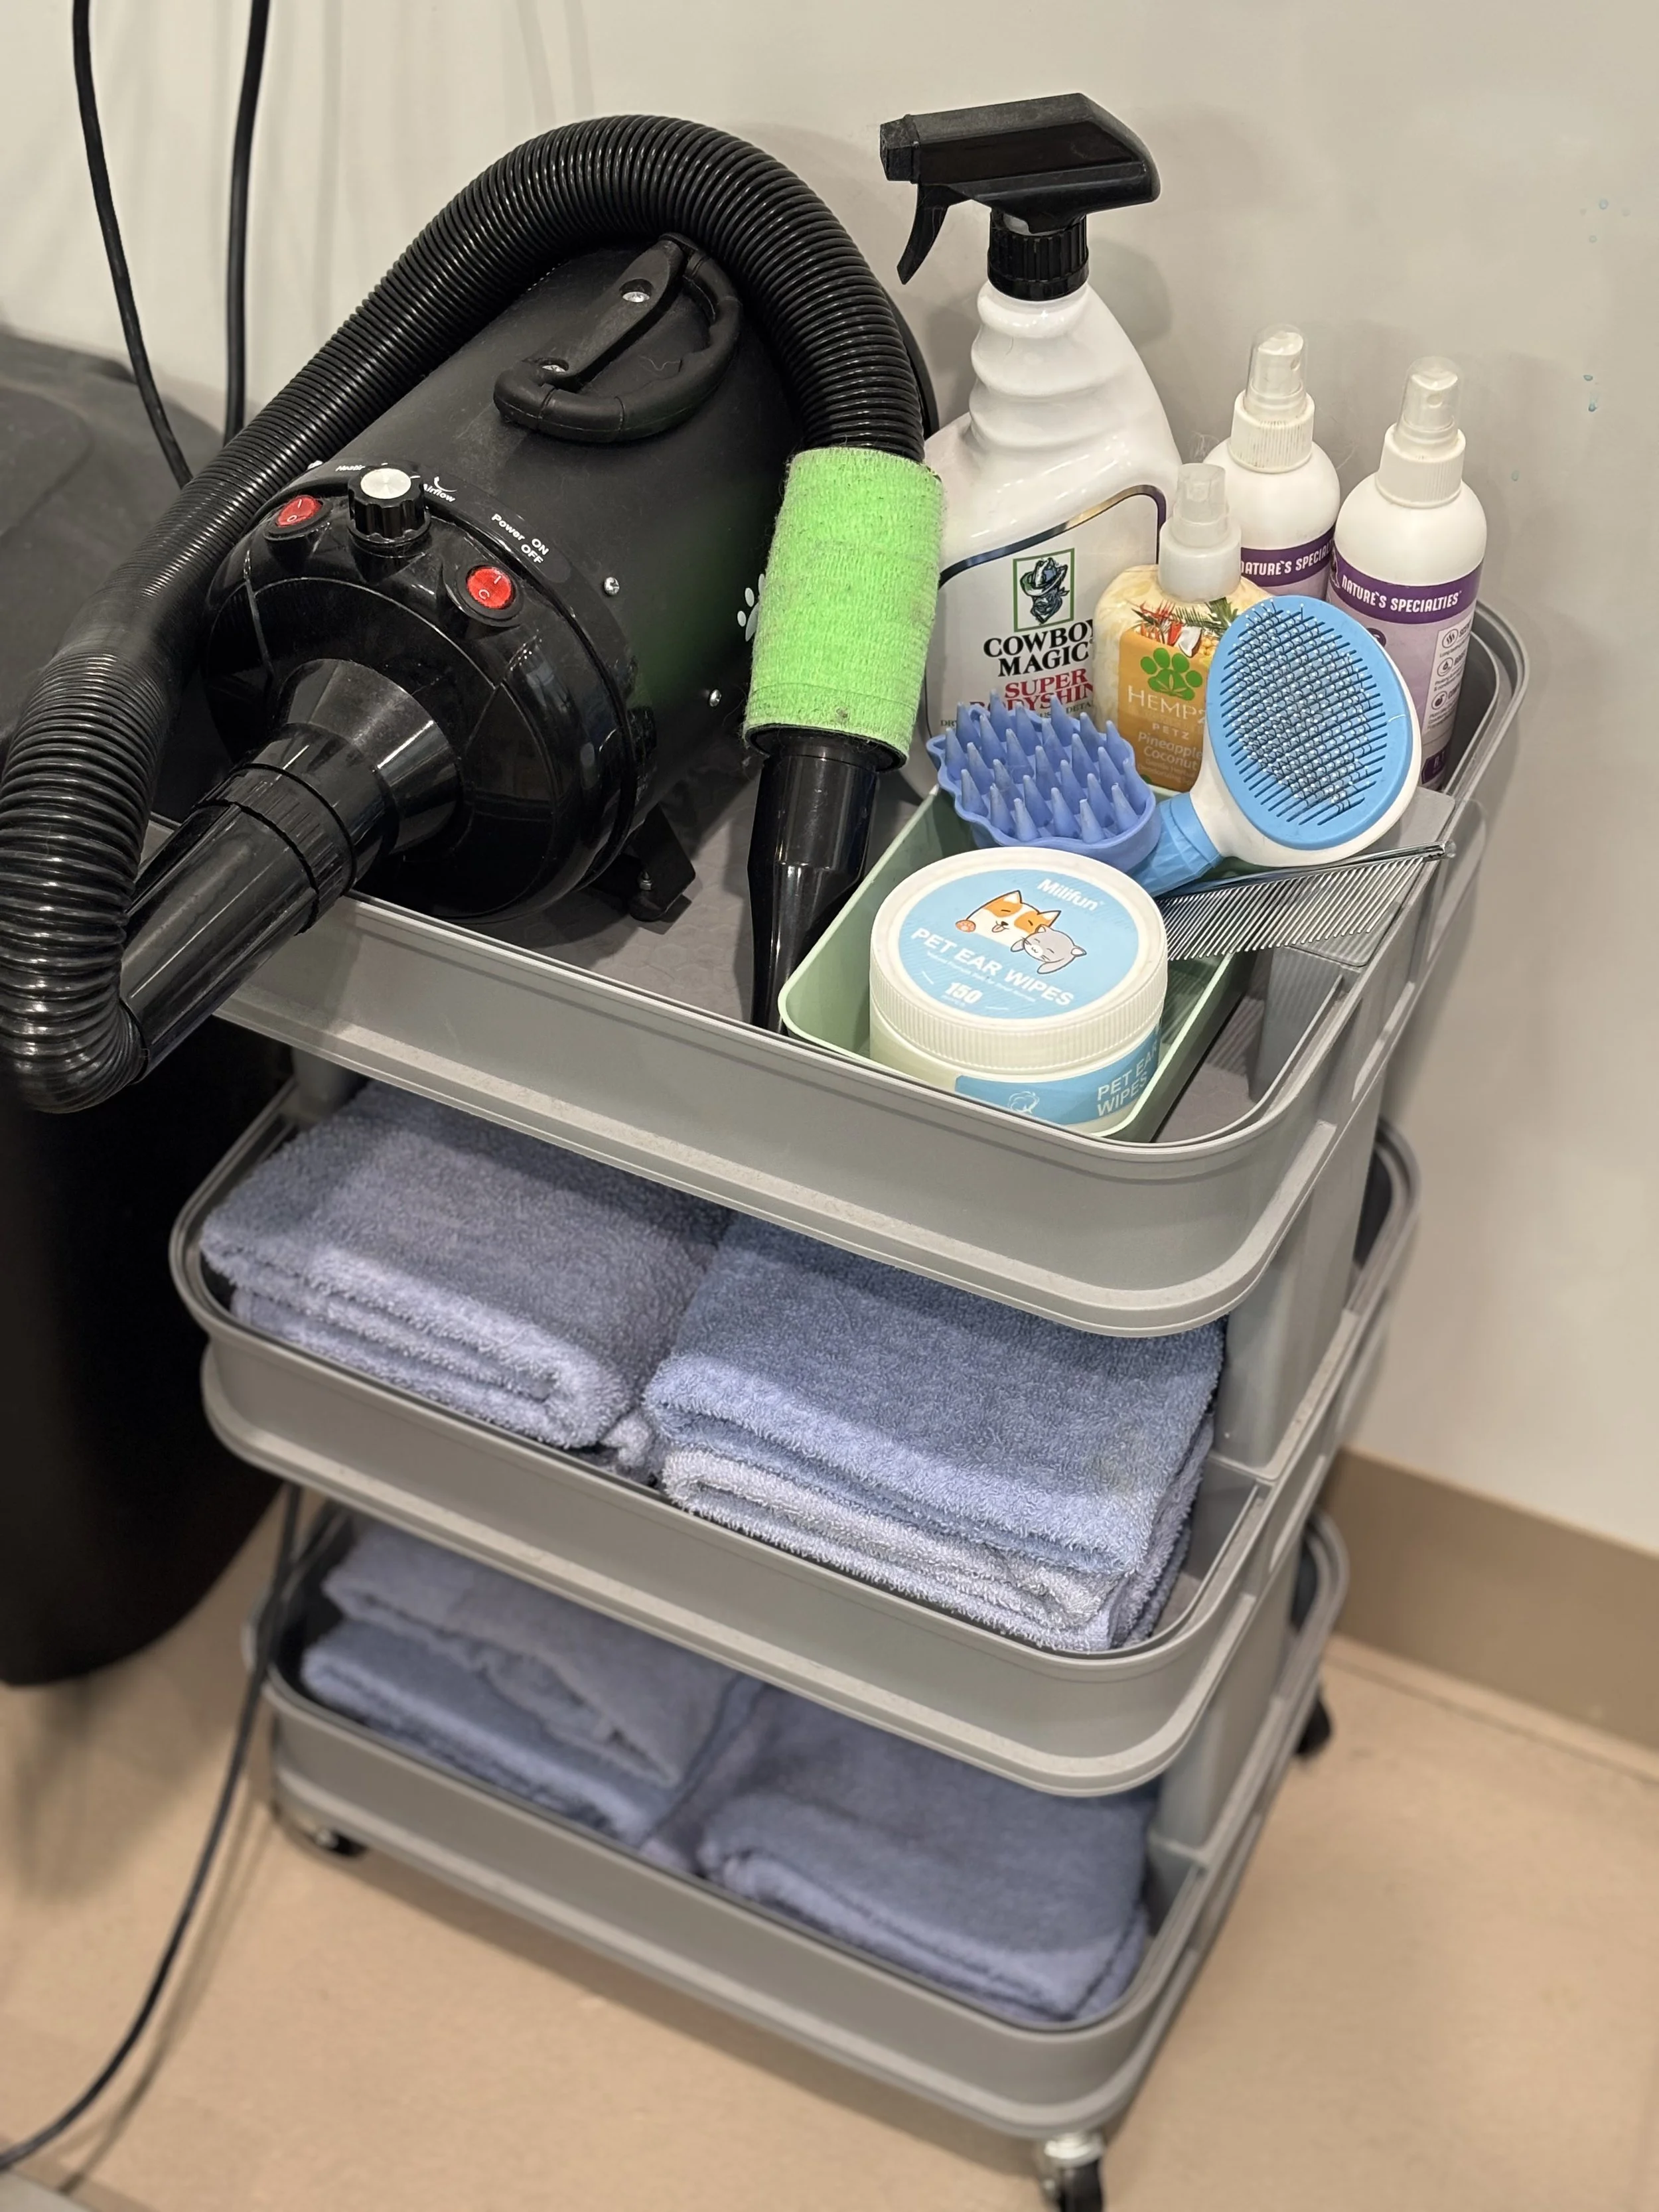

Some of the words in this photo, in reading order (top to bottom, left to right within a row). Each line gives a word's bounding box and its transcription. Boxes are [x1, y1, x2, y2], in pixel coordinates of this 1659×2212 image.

[423, 483, 455, 502] Airflow
[491, 514, 525, 540] Power
[521, 544, 543, 563] OFF
[532, 538, 549, 555] ON
[1342, 575, 1387, 608] NATURE'S
[1390, 592, 1459, 613] SPECIALTIES
[998, 642, 1089, 677] MAGIC
[970, 683, 1094, 711] DYSHIN
[1005, 668, 1088, 698] SUPER
[1066, 700, 1094, 714] DETA
[1138, 731, 1202, 760] Pineapple
[1152, 723, 1189, 740] PETZ
[1143, 746, 1197, 771] Coconut
[1037, 879, 1098, 911] Milifun
[910, 928, 958, 953] PET
[954, 948, 1003, 976] EAR
[1004, 969, 1075, 1005] WIPES
[945, 982, 983, 1003] 150
[1097, 1070, 1132, 1101] PET
[1097, 1071, 1147, 1116] WIPES
